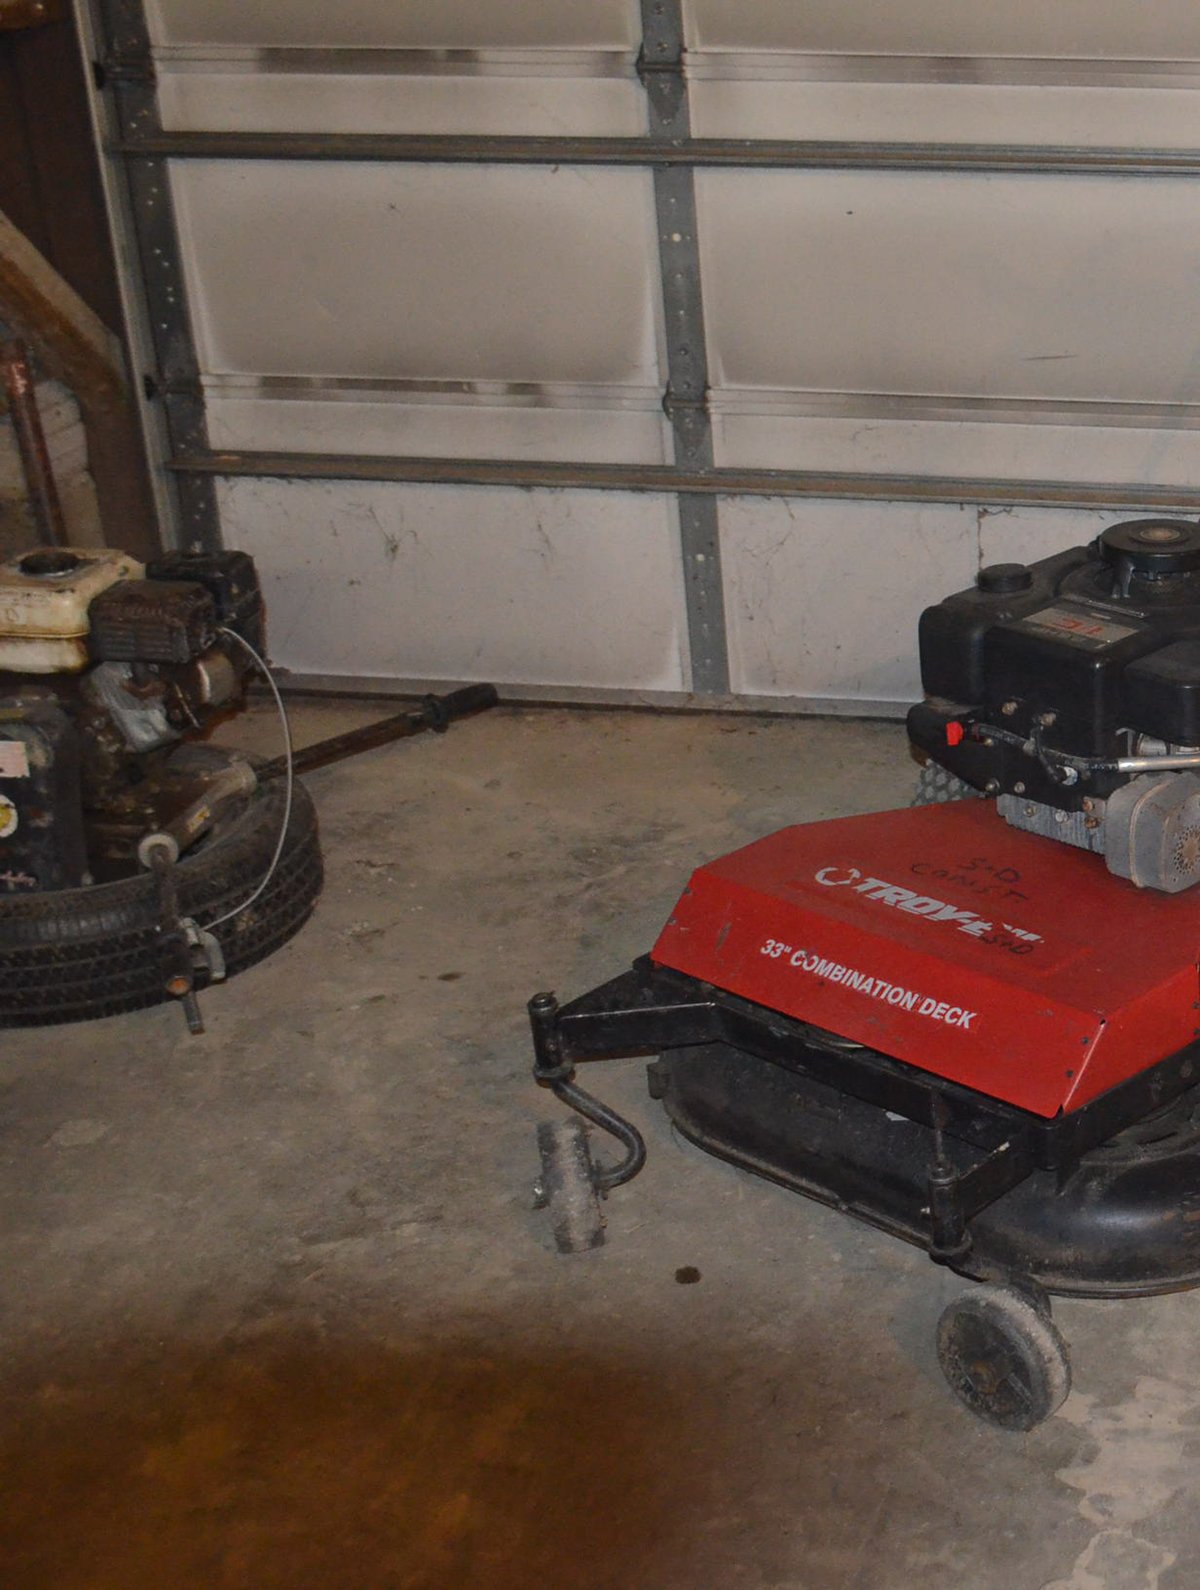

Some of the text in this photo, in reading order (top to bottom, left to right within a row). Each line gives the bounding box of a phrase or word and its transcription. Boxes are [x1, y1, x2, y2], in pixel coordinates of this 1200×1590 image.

[760, 939, 977, 1029] 33" COMBINATION DECK
